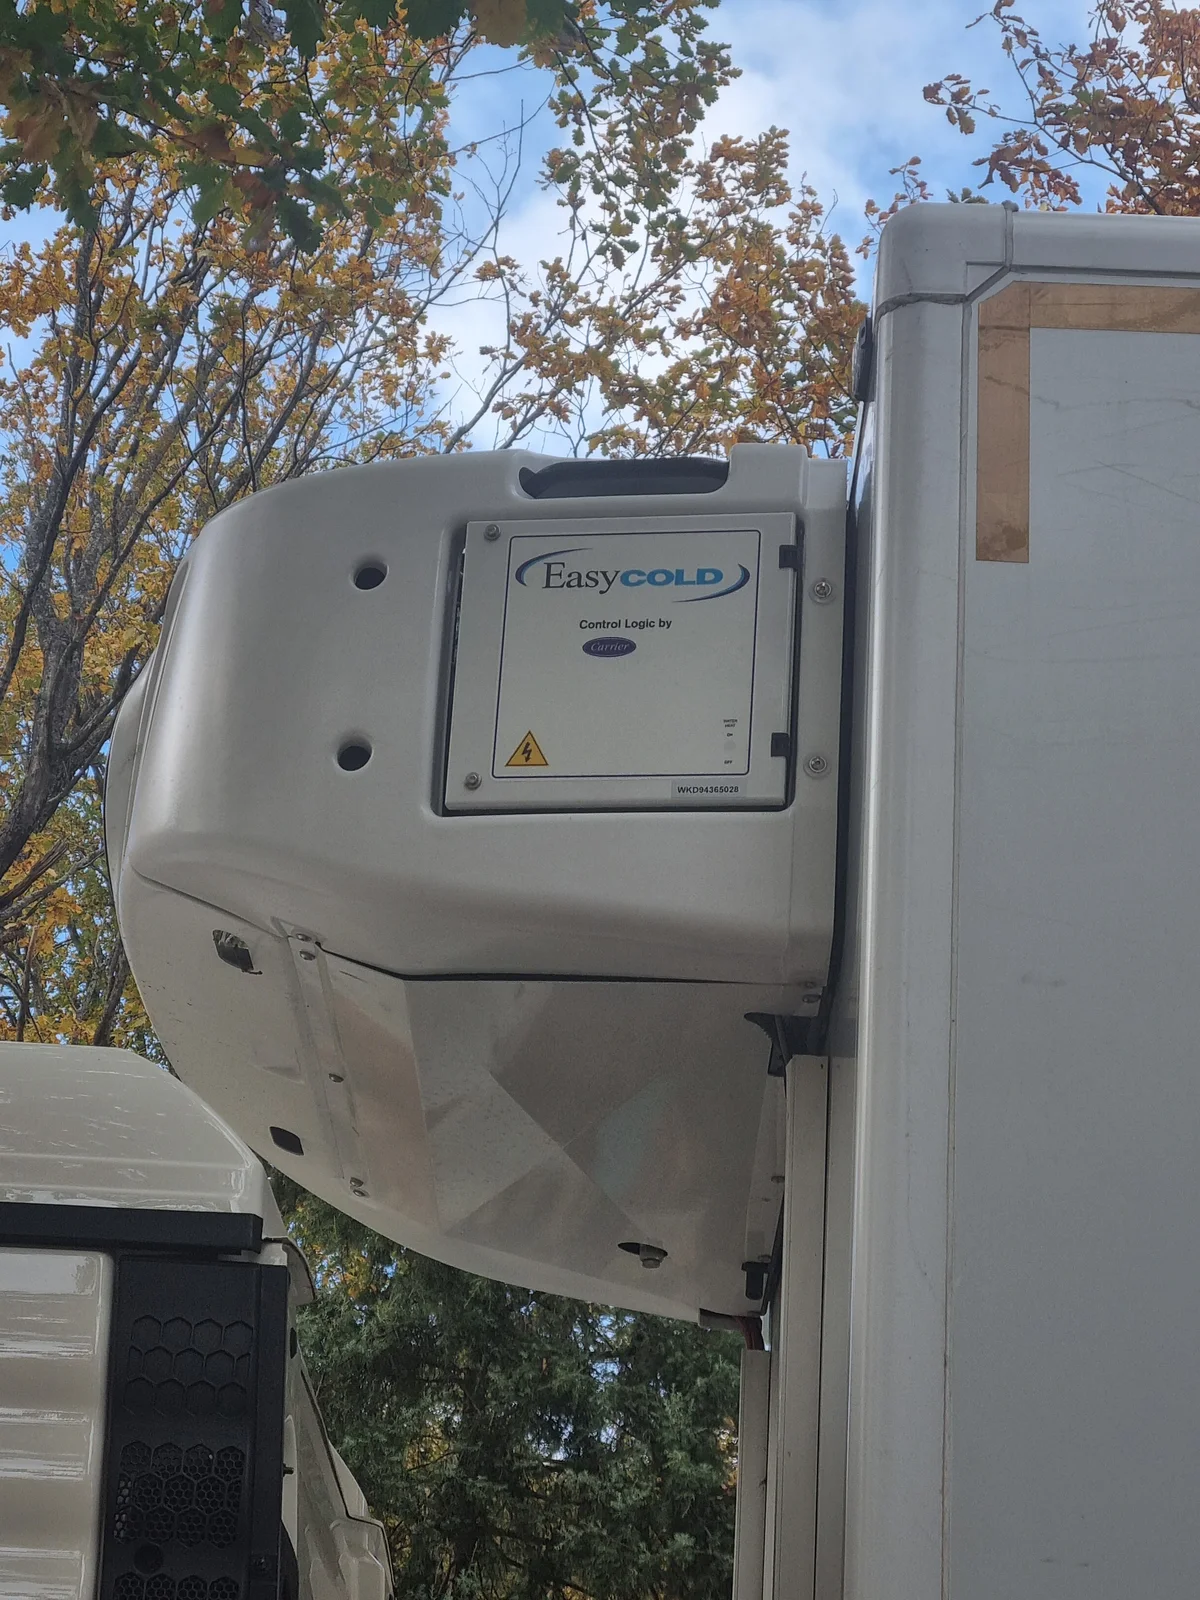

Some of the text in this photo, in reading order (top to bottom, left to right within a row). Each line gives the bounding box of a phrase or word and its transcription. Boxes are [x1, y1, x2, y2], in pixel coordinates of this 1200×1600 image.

[542, 562, 724, 595] EasyCOLD
[579, 617, 672, 630] Control Logic by
[590, 642, 630, 651] Carrier
[677, 786, 739, 794] WKD94365028
